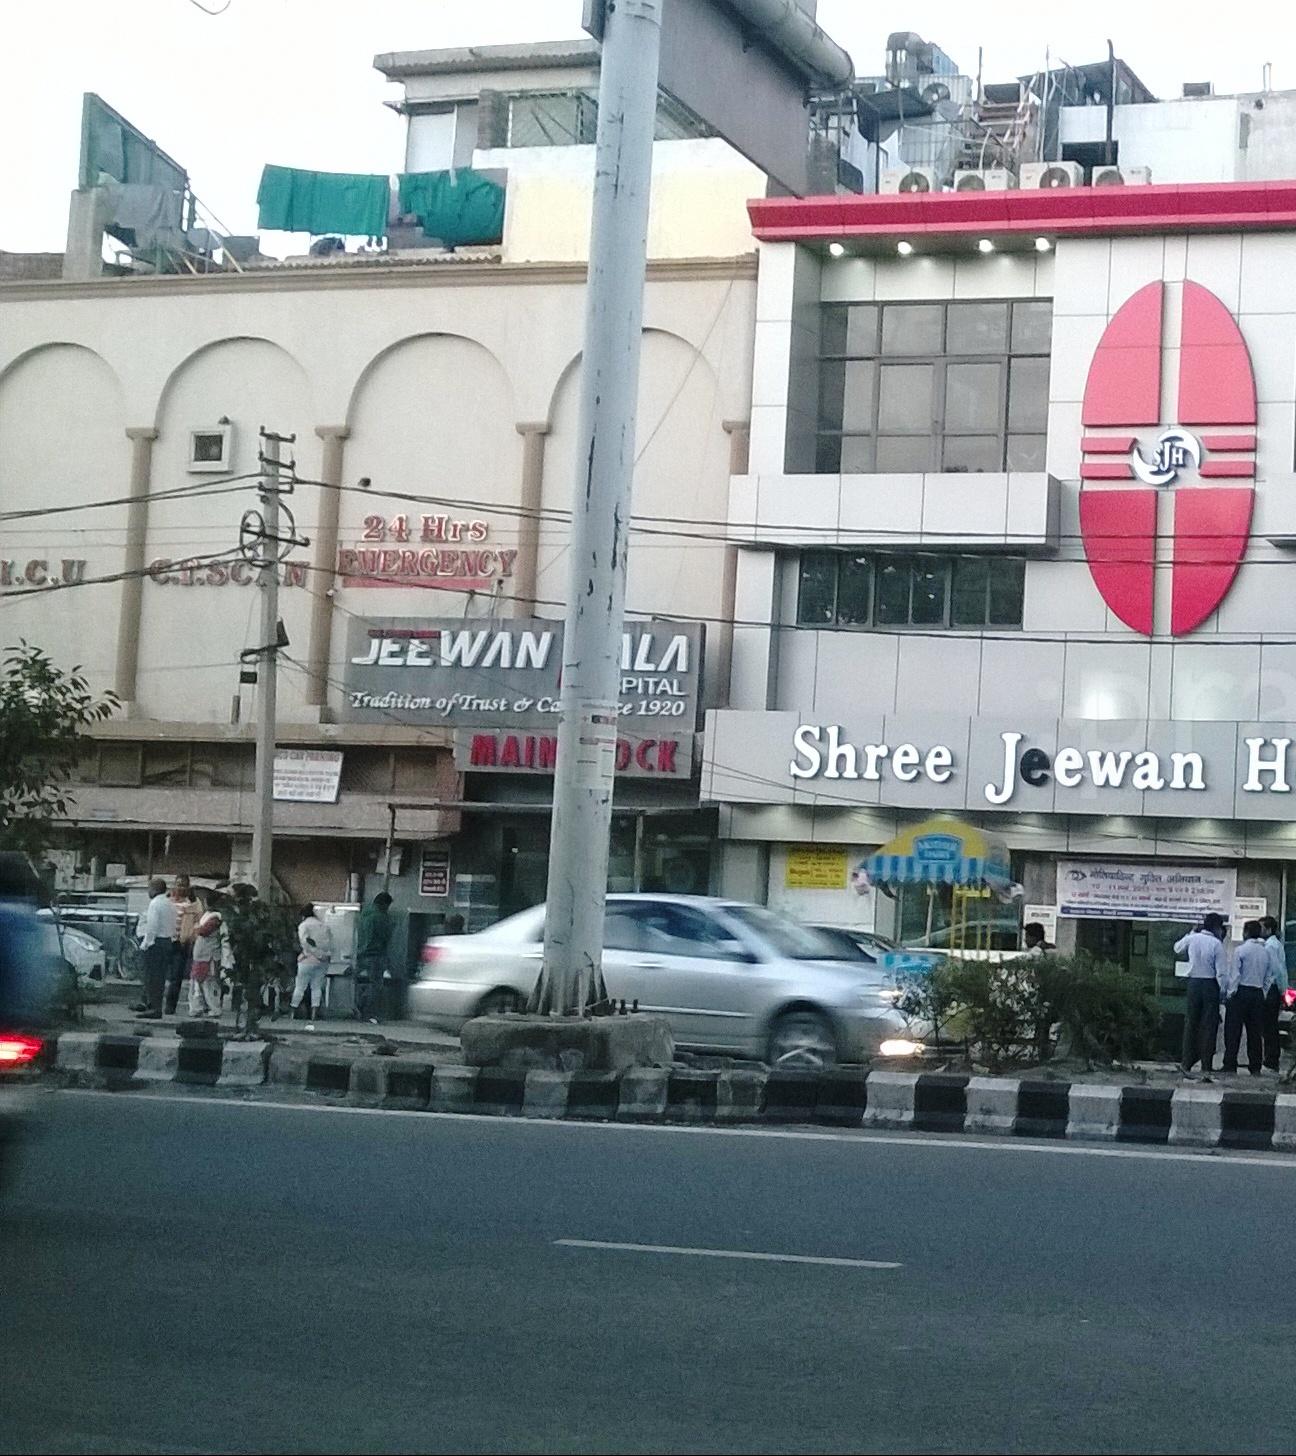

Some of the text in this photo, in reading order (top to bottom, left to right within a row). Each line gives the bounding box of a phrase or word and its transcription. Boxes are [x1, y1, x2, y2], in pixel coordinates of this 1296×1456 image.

[1152, 441, 1184, 471] SJH
[362, 514, 488, 542] 24 Hrs
[150, 557, 310, 587] C.T.SCN
[338, 549, 517, 577] EMERGENCY
[351, 630, 689, 672] JEEWAN LA
[621, 677, 688, 697] PITAL
[351, 691, 431, 710] Tradition
[436, 693, 461, 715] of
[459, 695, 508, 712] Trust
[513, 698, 534, 713] &
[536, 699, 561, 714] Ca
[637, 699, 685, 716] 1920
[470, 734, 679, 773] MAIN OCK
[790, 724, 953, 785] Shree
[984, 732, 1206, 804] Jeewan
